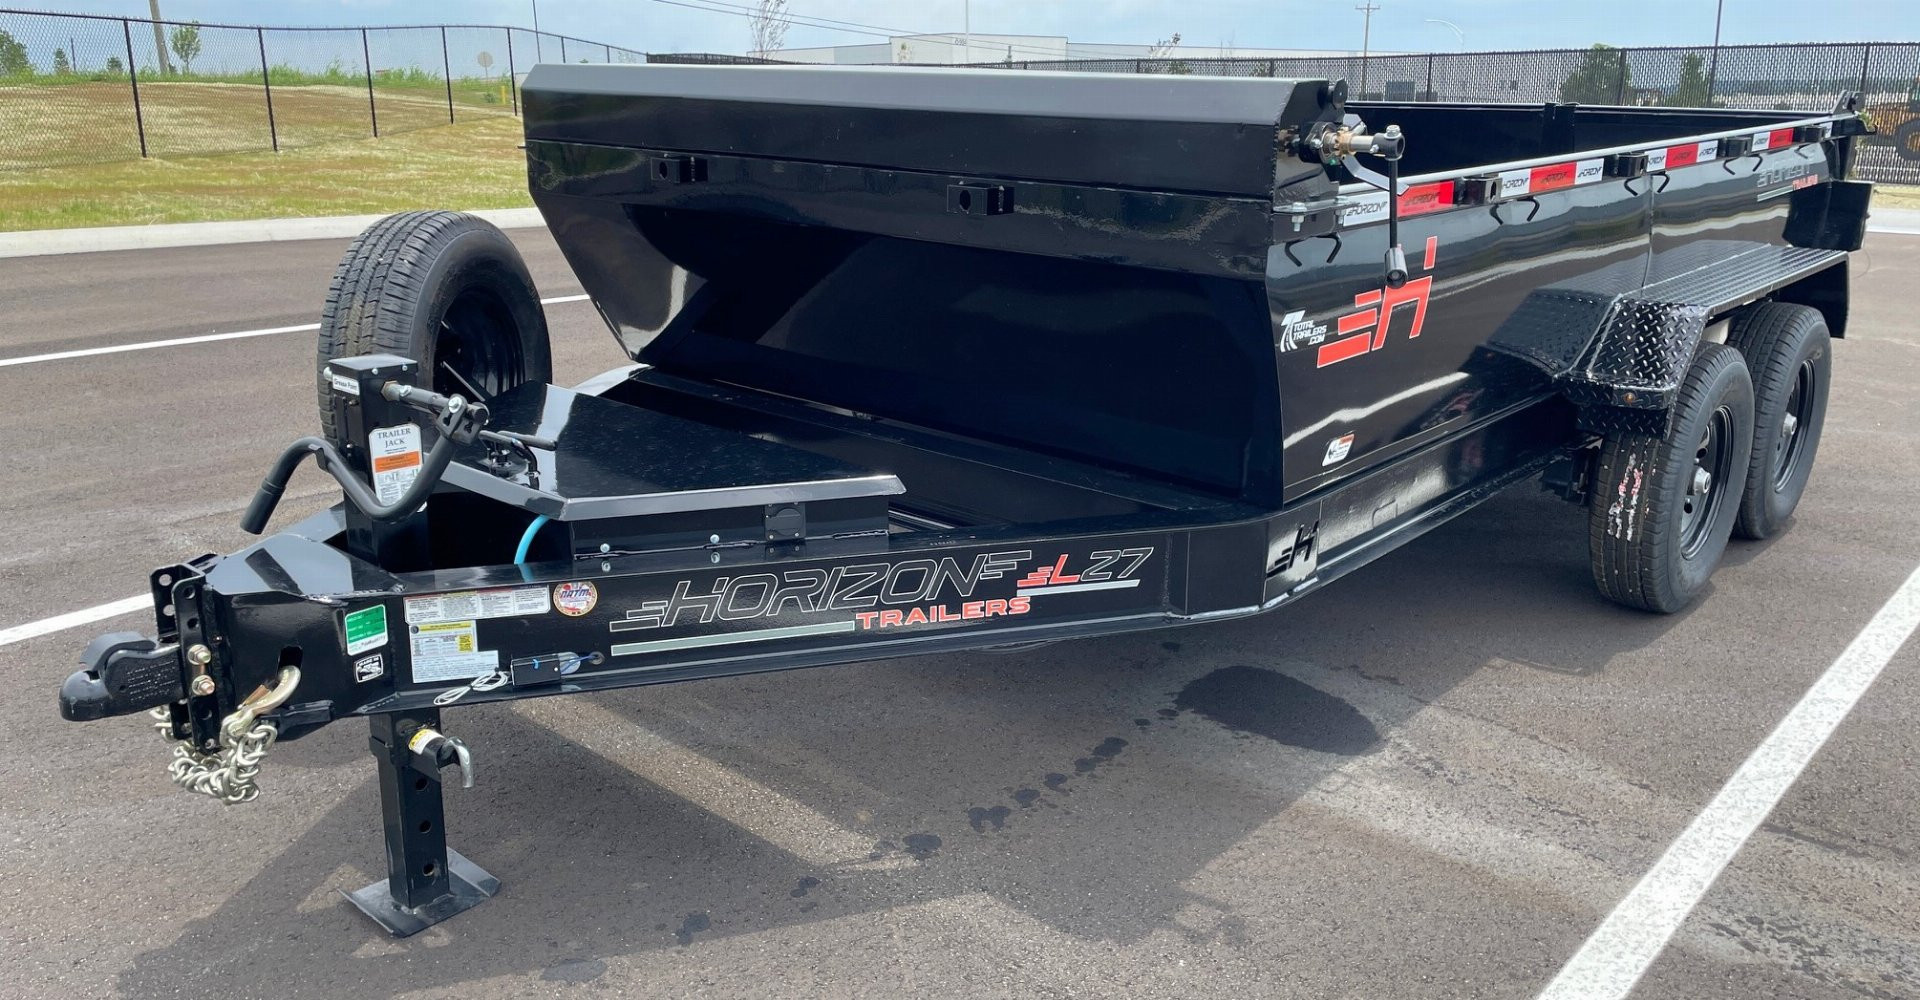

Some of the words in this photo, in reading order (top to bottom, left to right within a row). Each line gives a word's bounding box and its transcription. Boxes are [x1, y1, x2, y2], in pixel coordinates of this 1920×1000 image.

[1349, 202, 1387, 216] HORIZON
[1293, 320, 1315, 332] TOTAL
[1293, 325, 1328, 341] TRAILERS
[376, 427, 411, 439] TRAILER
[385, 439, 405, 448] JACK
[661, 553, 988, 628] HORIZON
[855, 596, 1031, 630] TRAILERS
